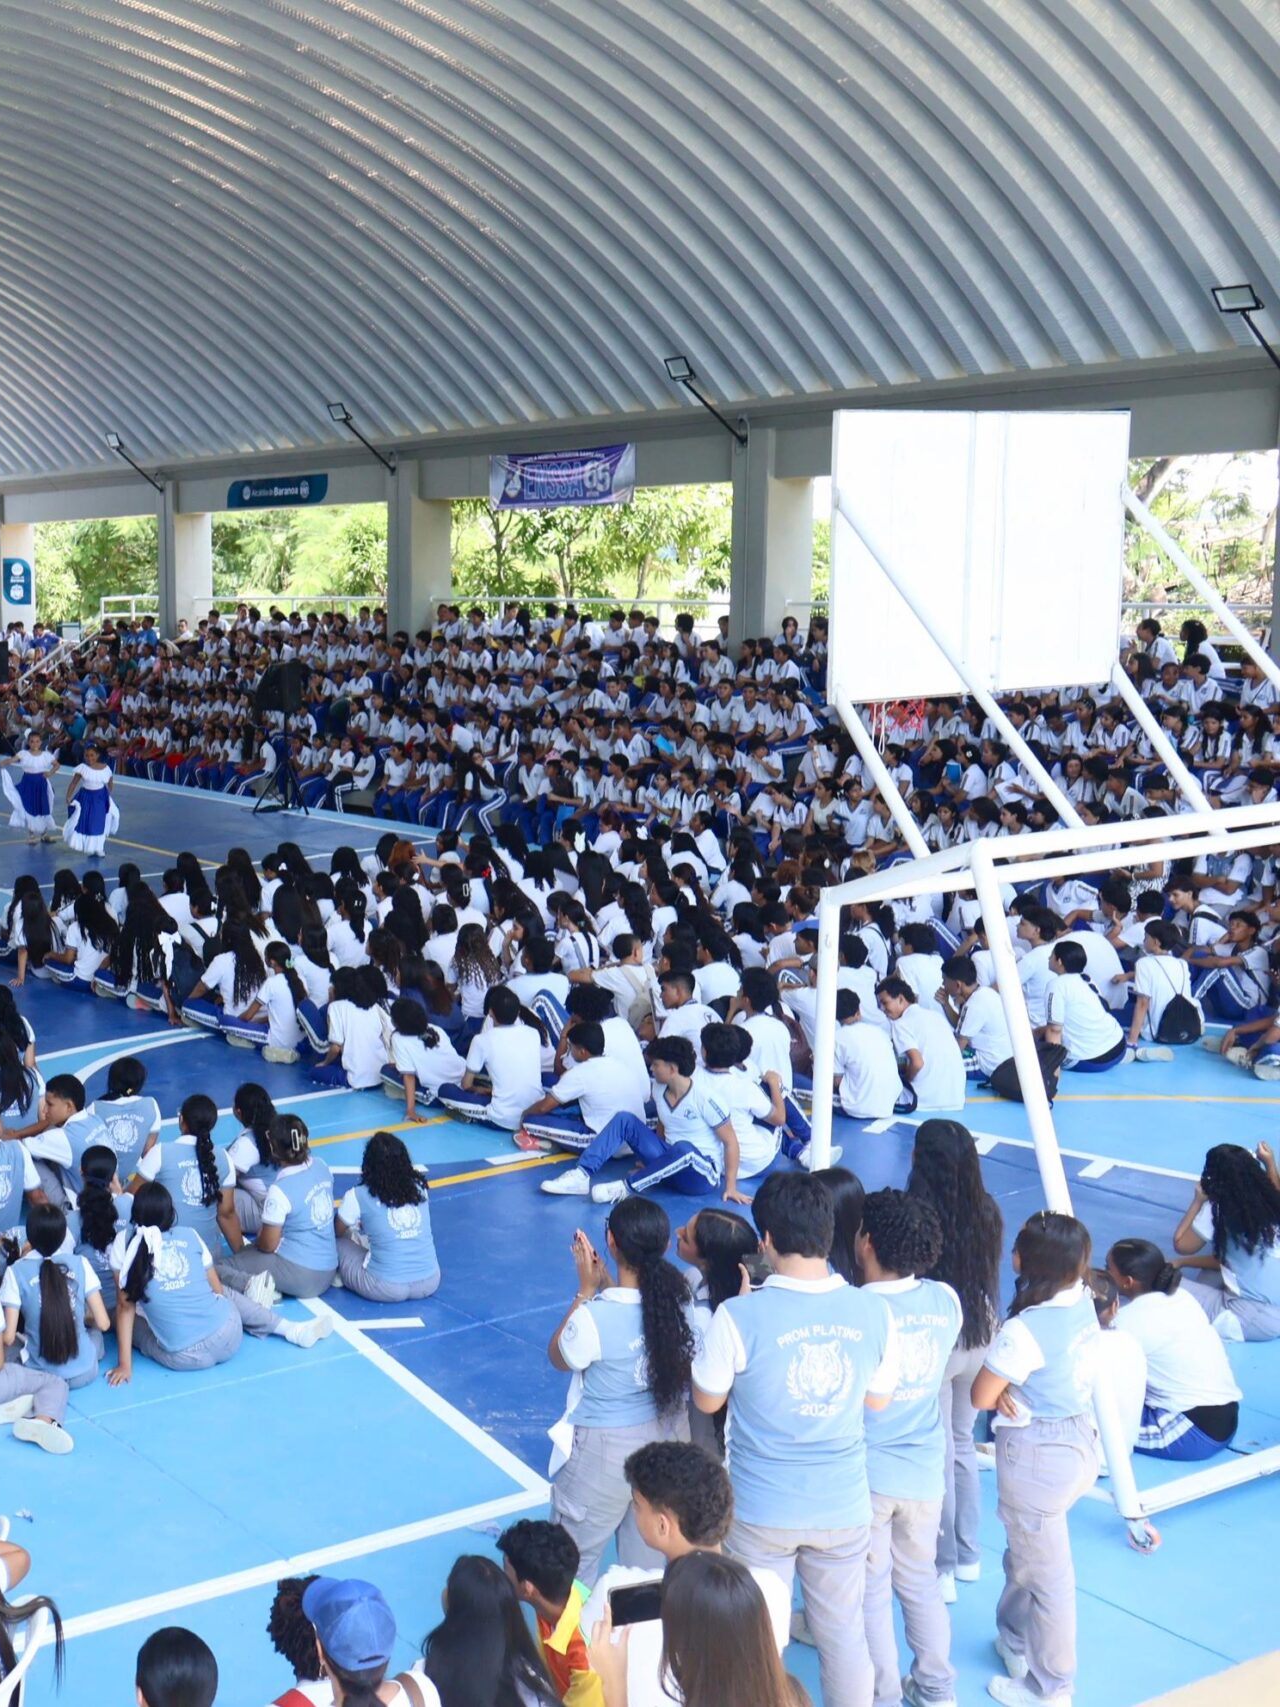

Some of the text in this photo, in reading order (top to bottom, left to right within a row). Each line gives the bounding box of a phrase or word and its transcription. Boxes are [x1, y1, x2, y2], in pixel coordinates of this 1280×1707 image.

[524, 461, 584, 500] ENSSA
[274, 486, 299, 496] Baranoa
[906, 1314, 949, 1328] PLATINO
[776, 1324, 864, 1349] PROM PLATINO
